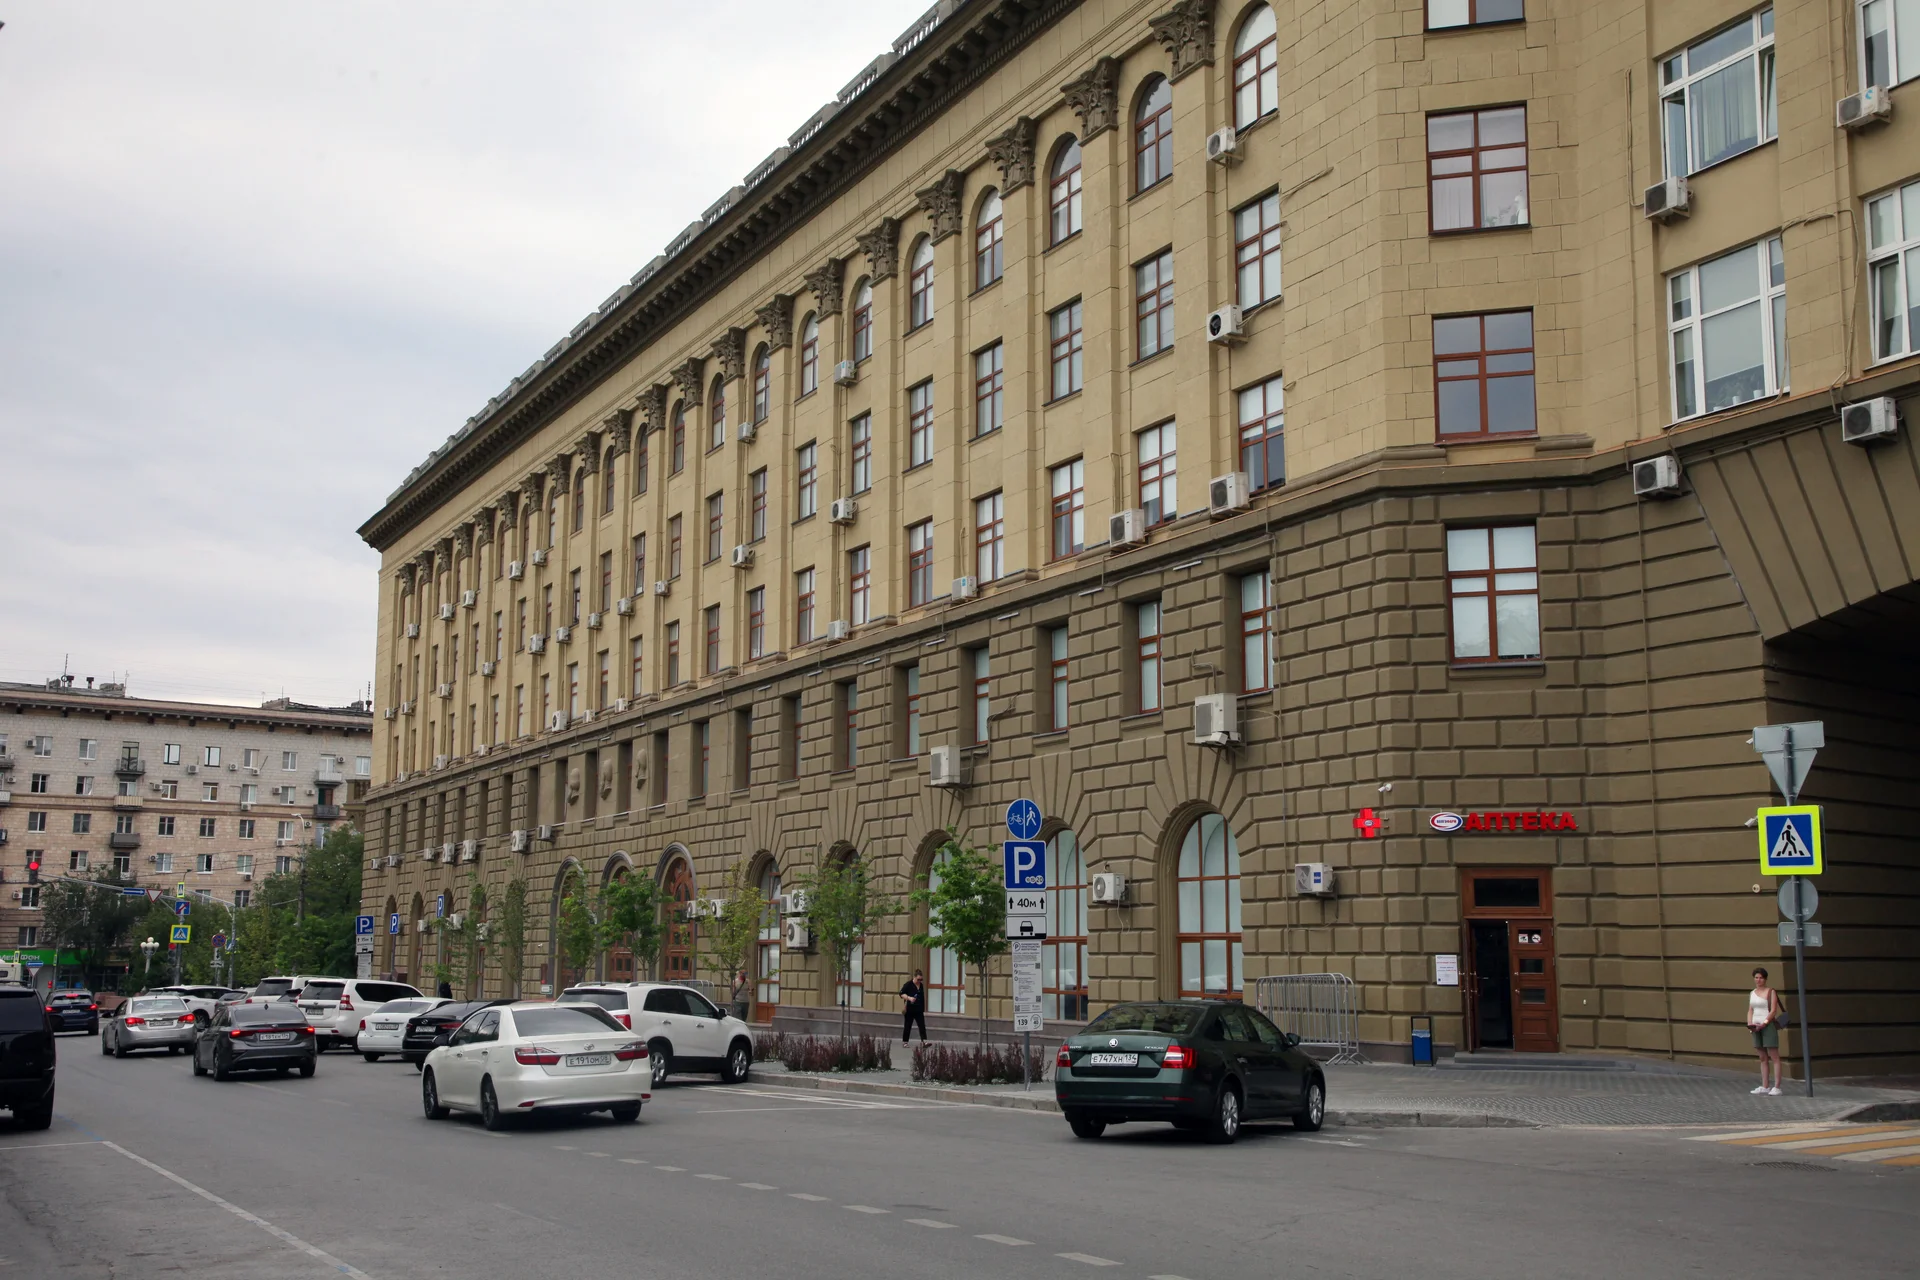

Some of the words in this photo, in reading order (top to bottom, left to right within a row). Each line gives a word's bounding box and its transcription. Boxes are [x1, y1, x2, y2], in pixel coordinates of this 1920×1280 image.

[1464, 811, 1577, 831] АПТЕКА
[1013, 846, 1036, 884] P
[359, 918, 370, 933] P
